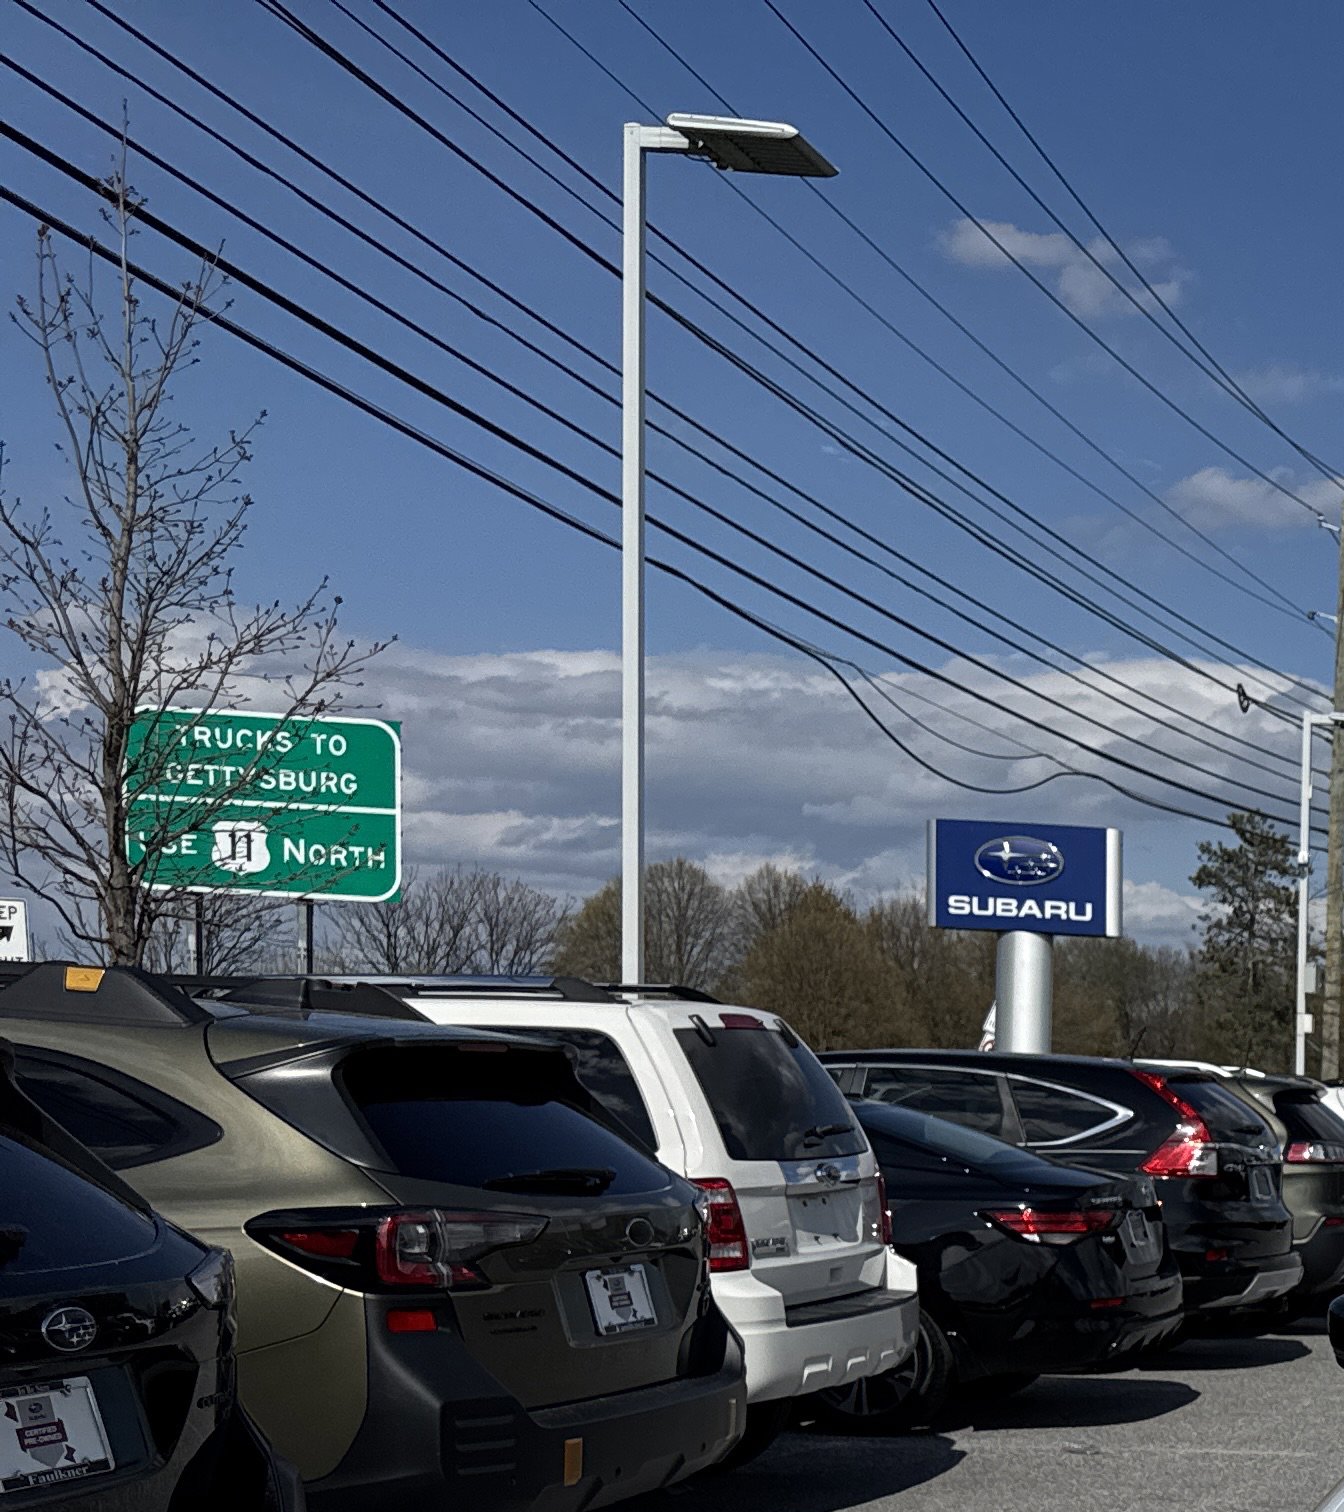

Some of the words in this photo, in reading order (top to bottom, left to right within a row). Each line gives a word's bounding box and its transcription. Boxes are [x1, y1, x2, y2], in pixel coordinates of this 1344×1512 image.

[176, 725, 293, 753] TRUCKS
[311, 733, 347, 757] TO
[166, 762, 358, 795] GETTYSBURG
[229, 830, 252, 862] 11
[947, 895, 1093, 922] SUBARU
[28, 1465, 89, 1486] Faulkner
